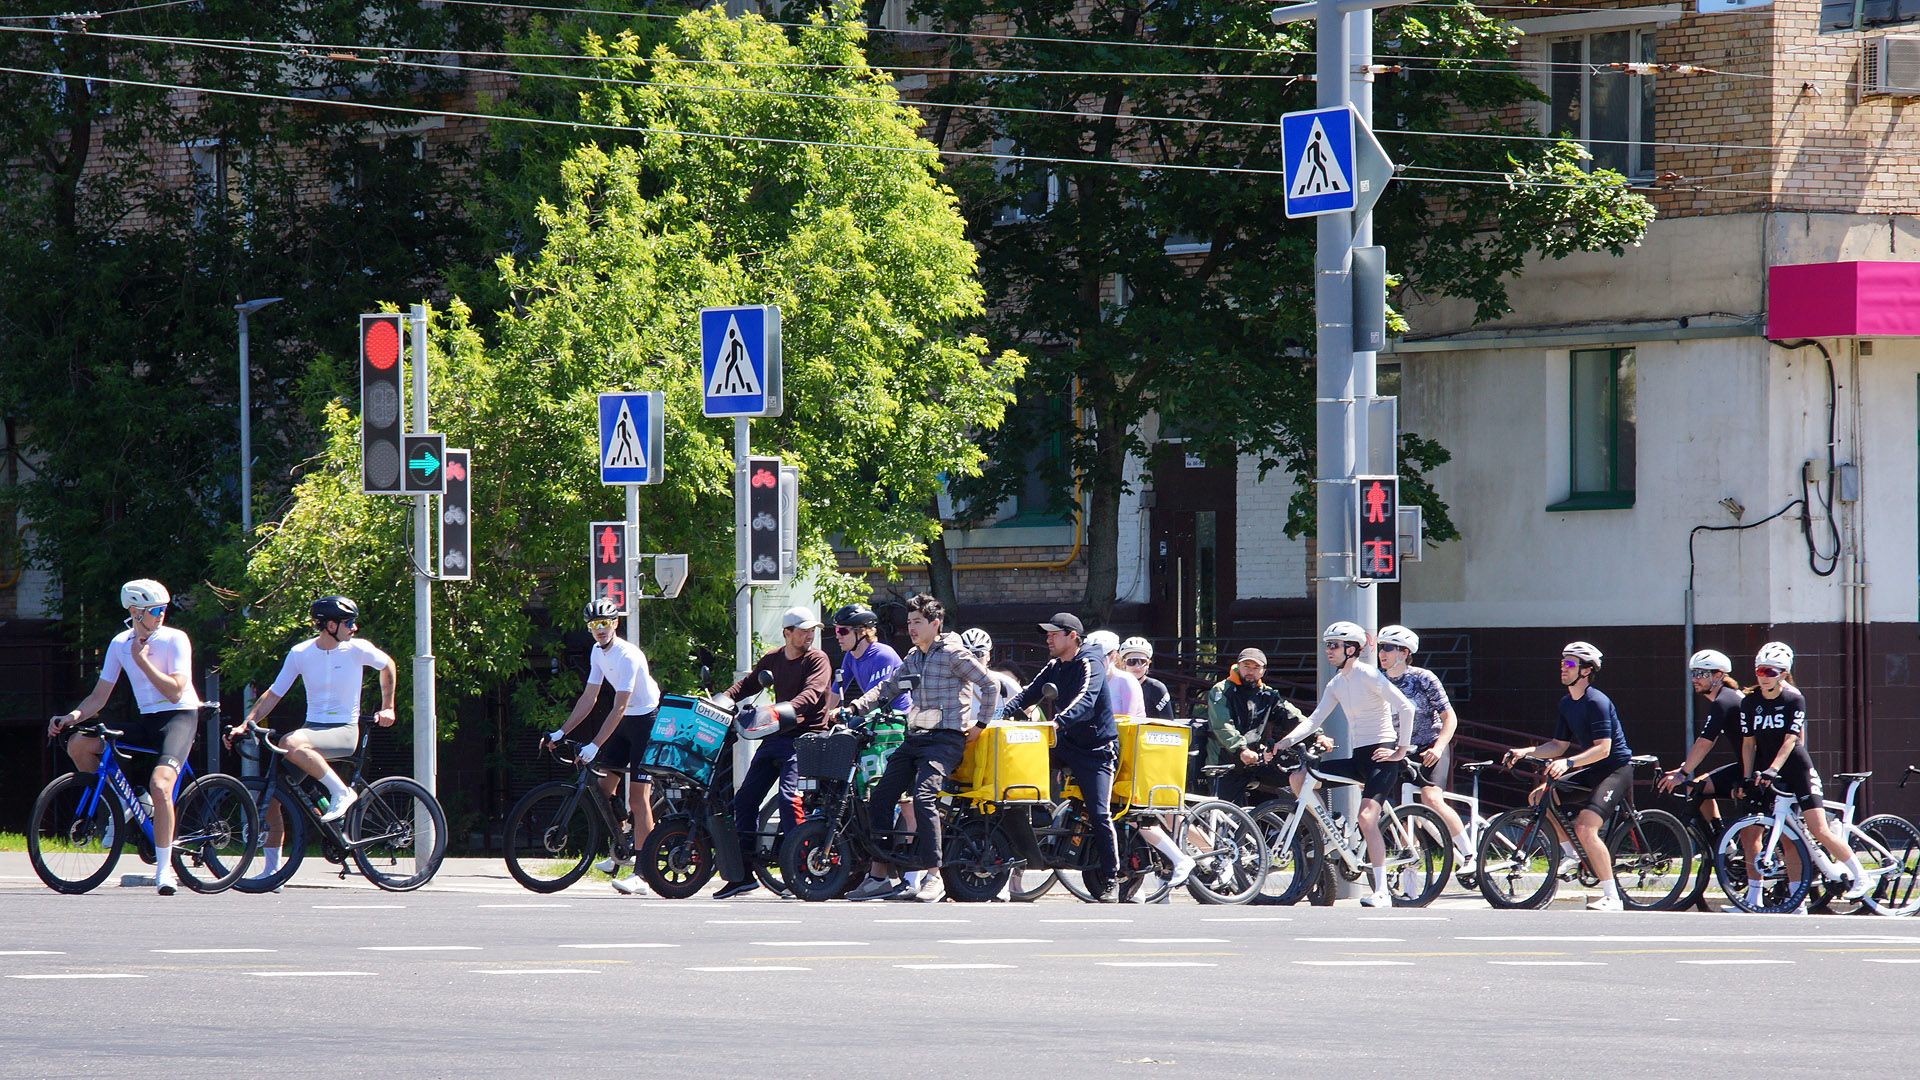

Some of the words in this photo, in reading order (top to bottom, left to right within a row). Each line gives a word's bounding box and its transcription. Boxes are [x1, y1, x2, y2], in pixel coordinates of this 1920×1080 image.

[656, 723, 674, 736] fresh
[1753, 713, 1785, 730] PAS
[1790, 710, 1806, 733] PAS
[1808, 767, 1824, 797] PAS
[1314, 805, 1349, 852] Bianchi
